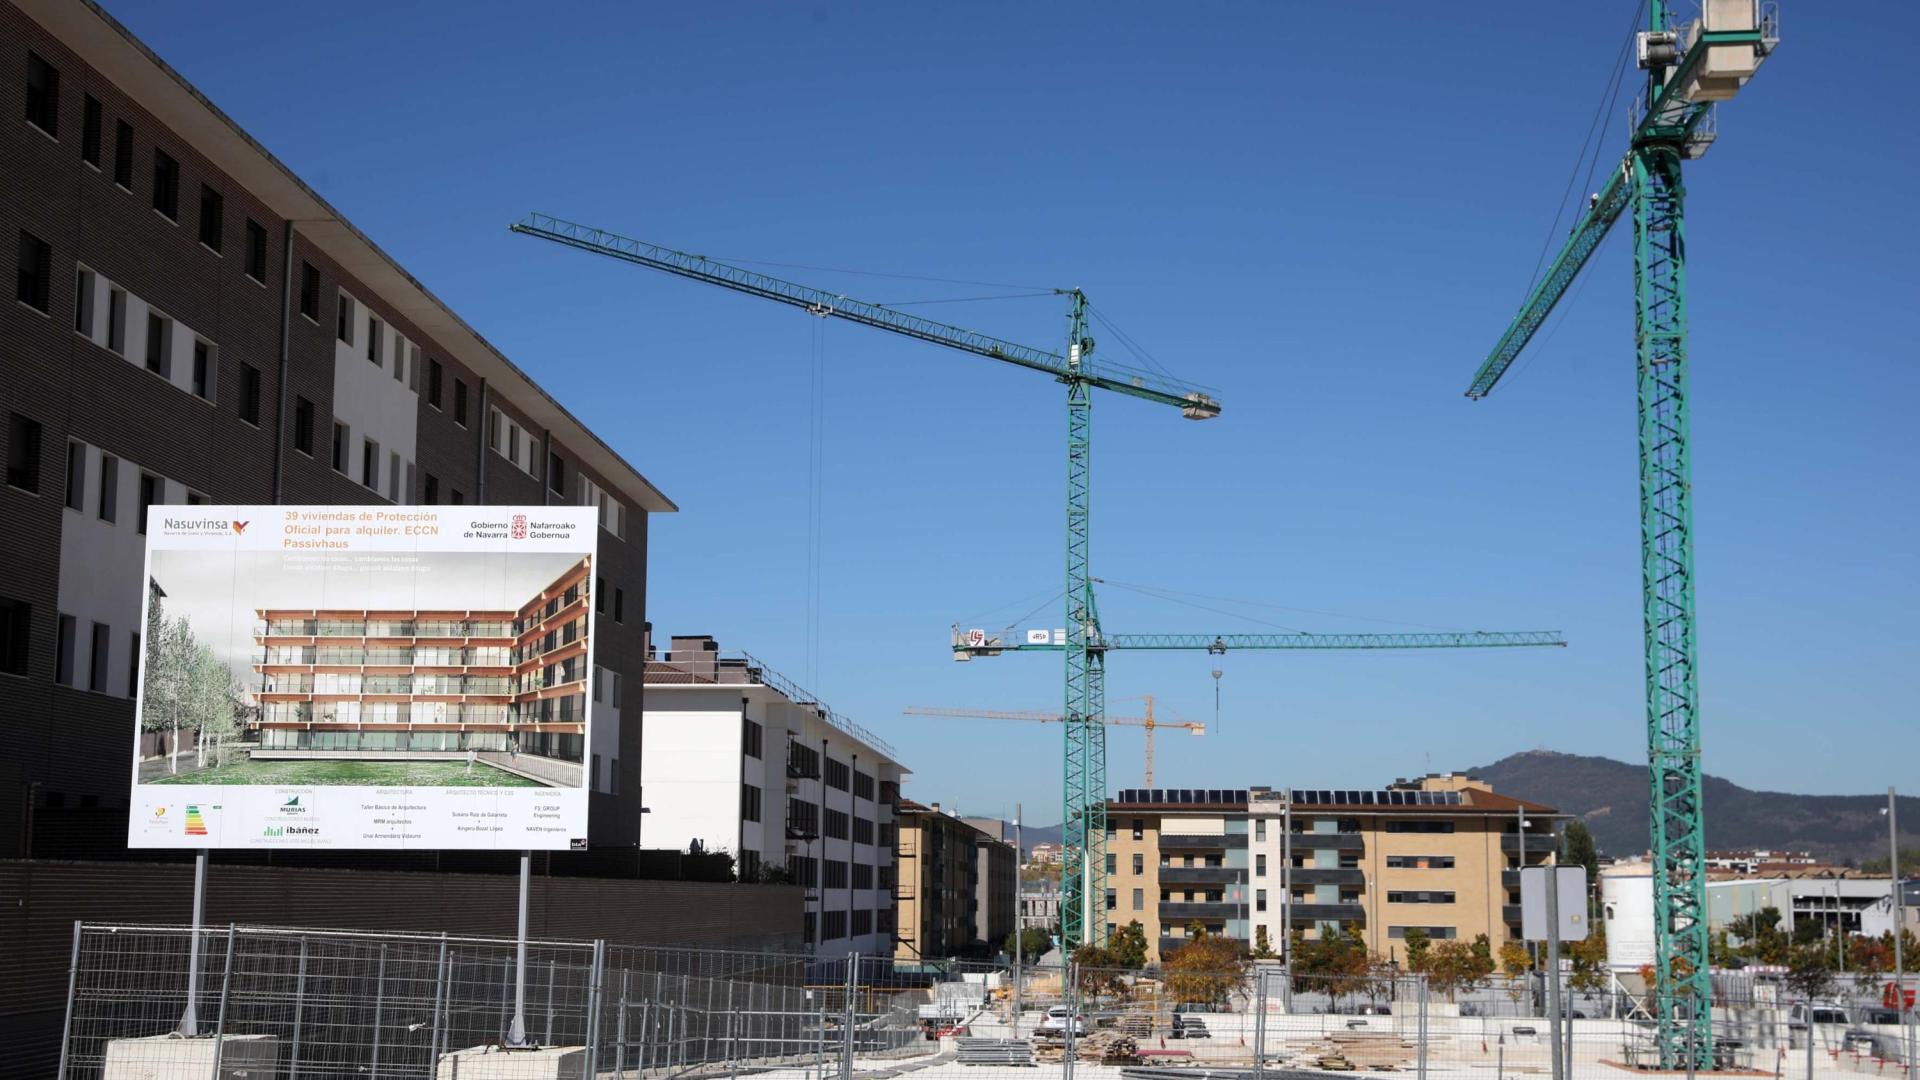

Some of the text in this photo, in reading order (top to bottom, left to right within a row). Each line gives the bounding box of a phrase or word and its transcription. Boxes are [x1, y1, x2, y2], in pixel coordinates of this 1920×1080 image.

[285, 511, 438, 521] 39 viviendas de Protección
[164, 517, 228, 529] Nasuvinsa
[470, 521, 508, 529] Gobierno
[530, 522, 576, 530] Nafarroako
[284, 525, 439, 537] Oficial para alquiler. ECCN
[463, 531, 508, 539] de Navarra
[529, 531, 570, 539] Gobernua
[283, 538, 349, 549] Passivhaus
[286, 825, 319, 834] ibáñez
